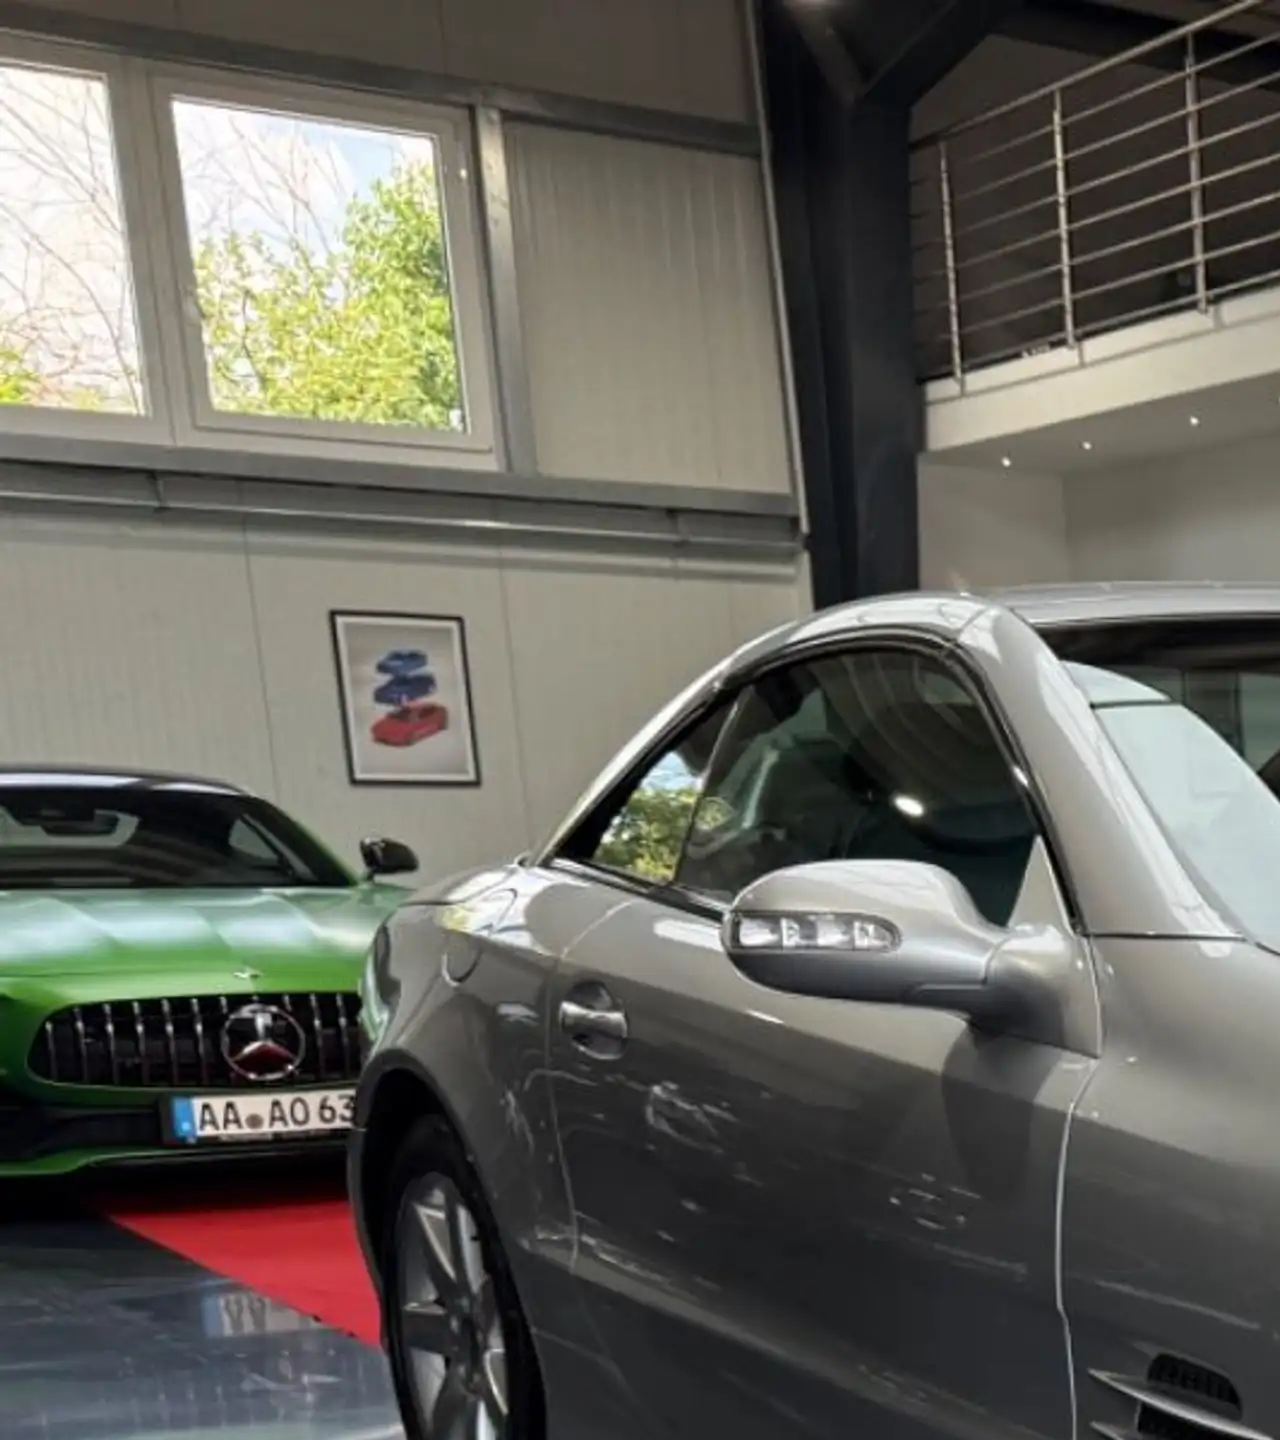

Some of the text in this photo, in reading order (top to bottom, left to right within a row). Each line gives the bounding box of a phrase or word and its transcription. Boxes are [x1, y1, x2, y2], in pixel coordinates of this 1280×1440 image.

[199, 1094, 357, 1131] AA AO 63
